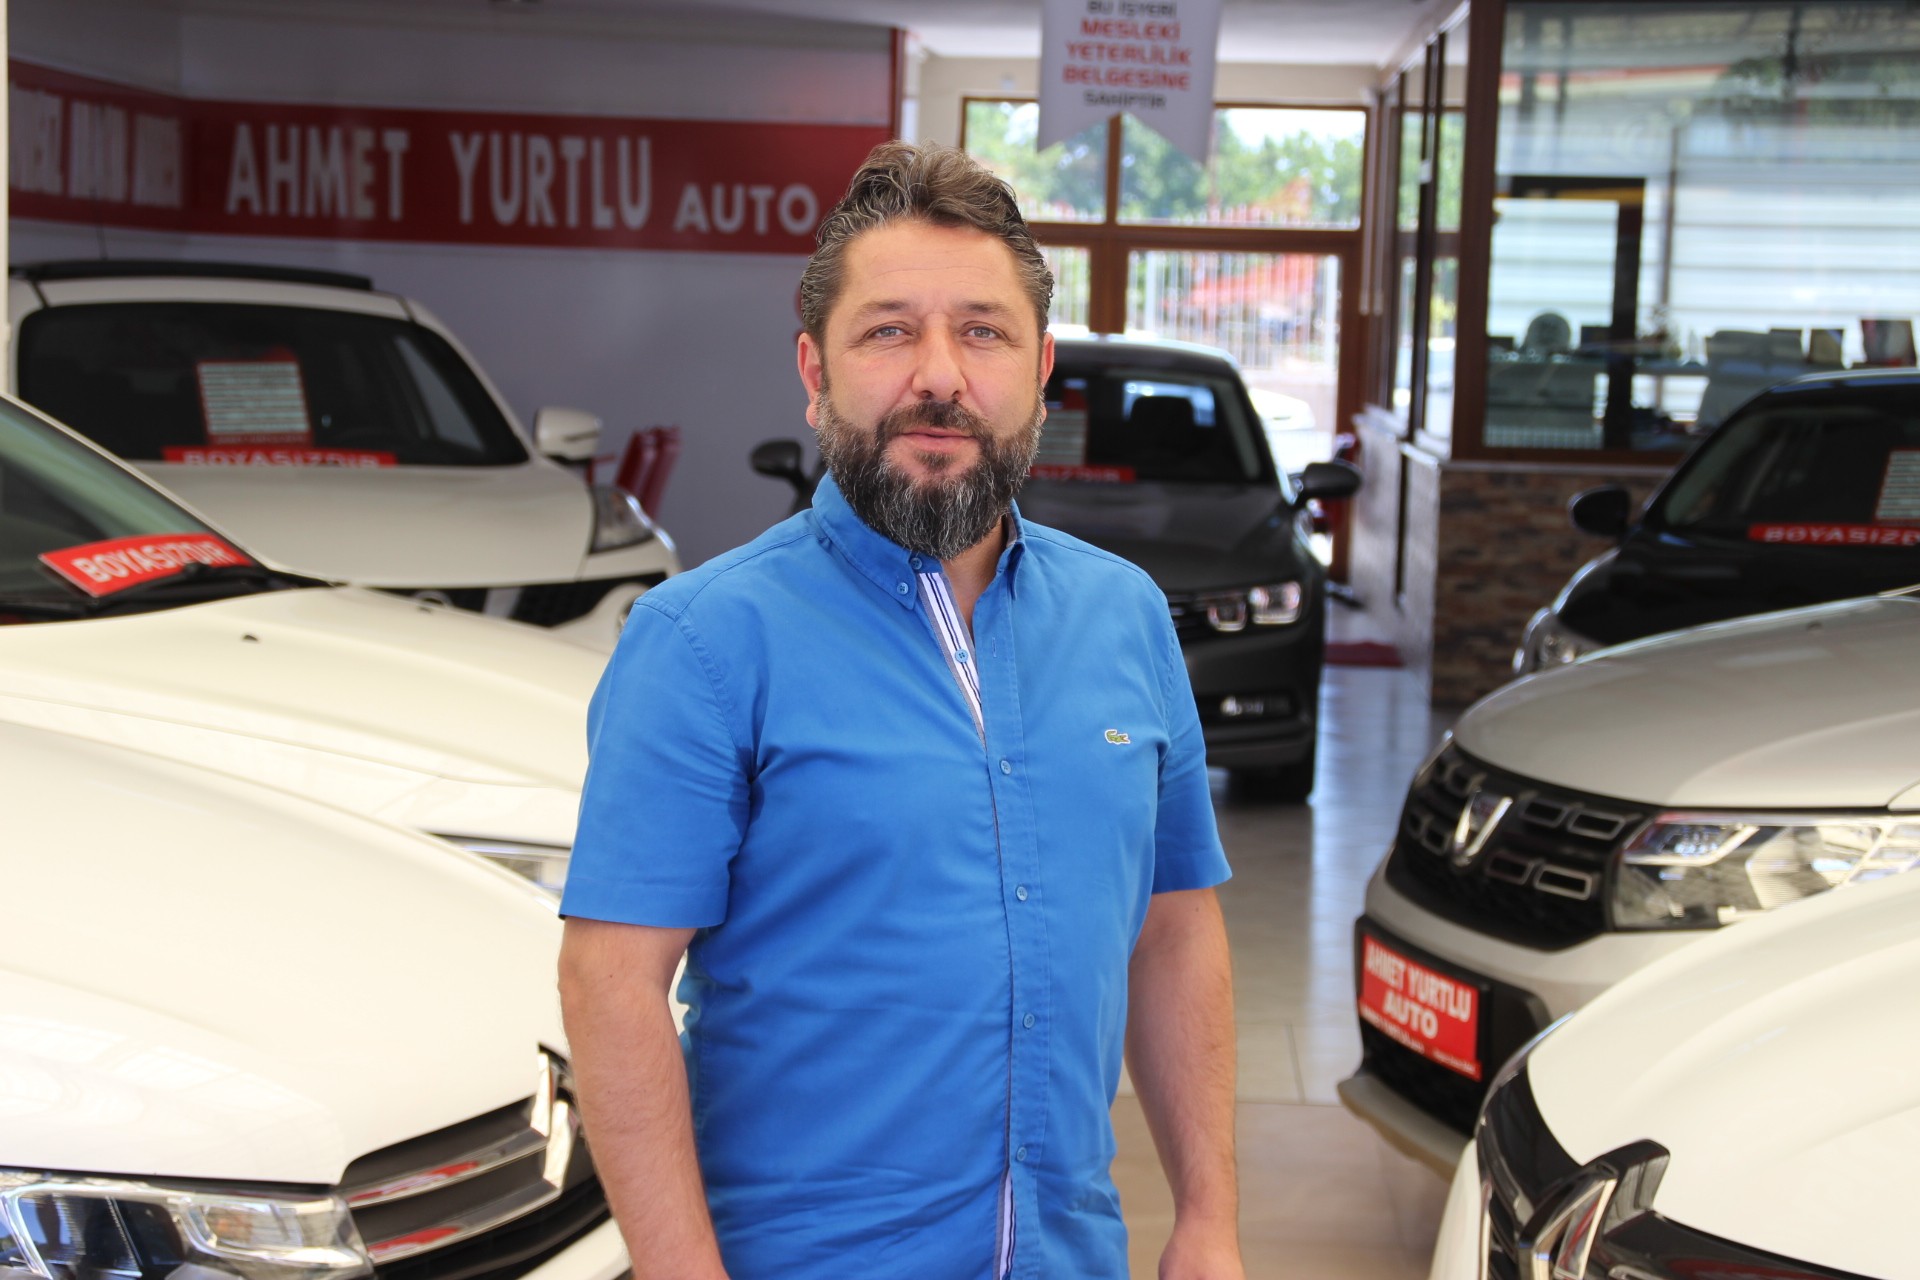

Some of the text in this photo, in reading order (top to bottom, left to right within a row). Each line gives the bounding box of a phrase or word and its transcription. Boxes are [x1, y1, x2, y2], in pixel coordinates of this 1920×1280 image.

[225, 123, 410, 222] AHMET
[449, 132, 651, 231] YURTLU
[673, 183, 819, 235] AUTO
[1366, 942, 1473, 1023] AHMET YURTLU
[1383, 990, 1439, 1040] AUTO
